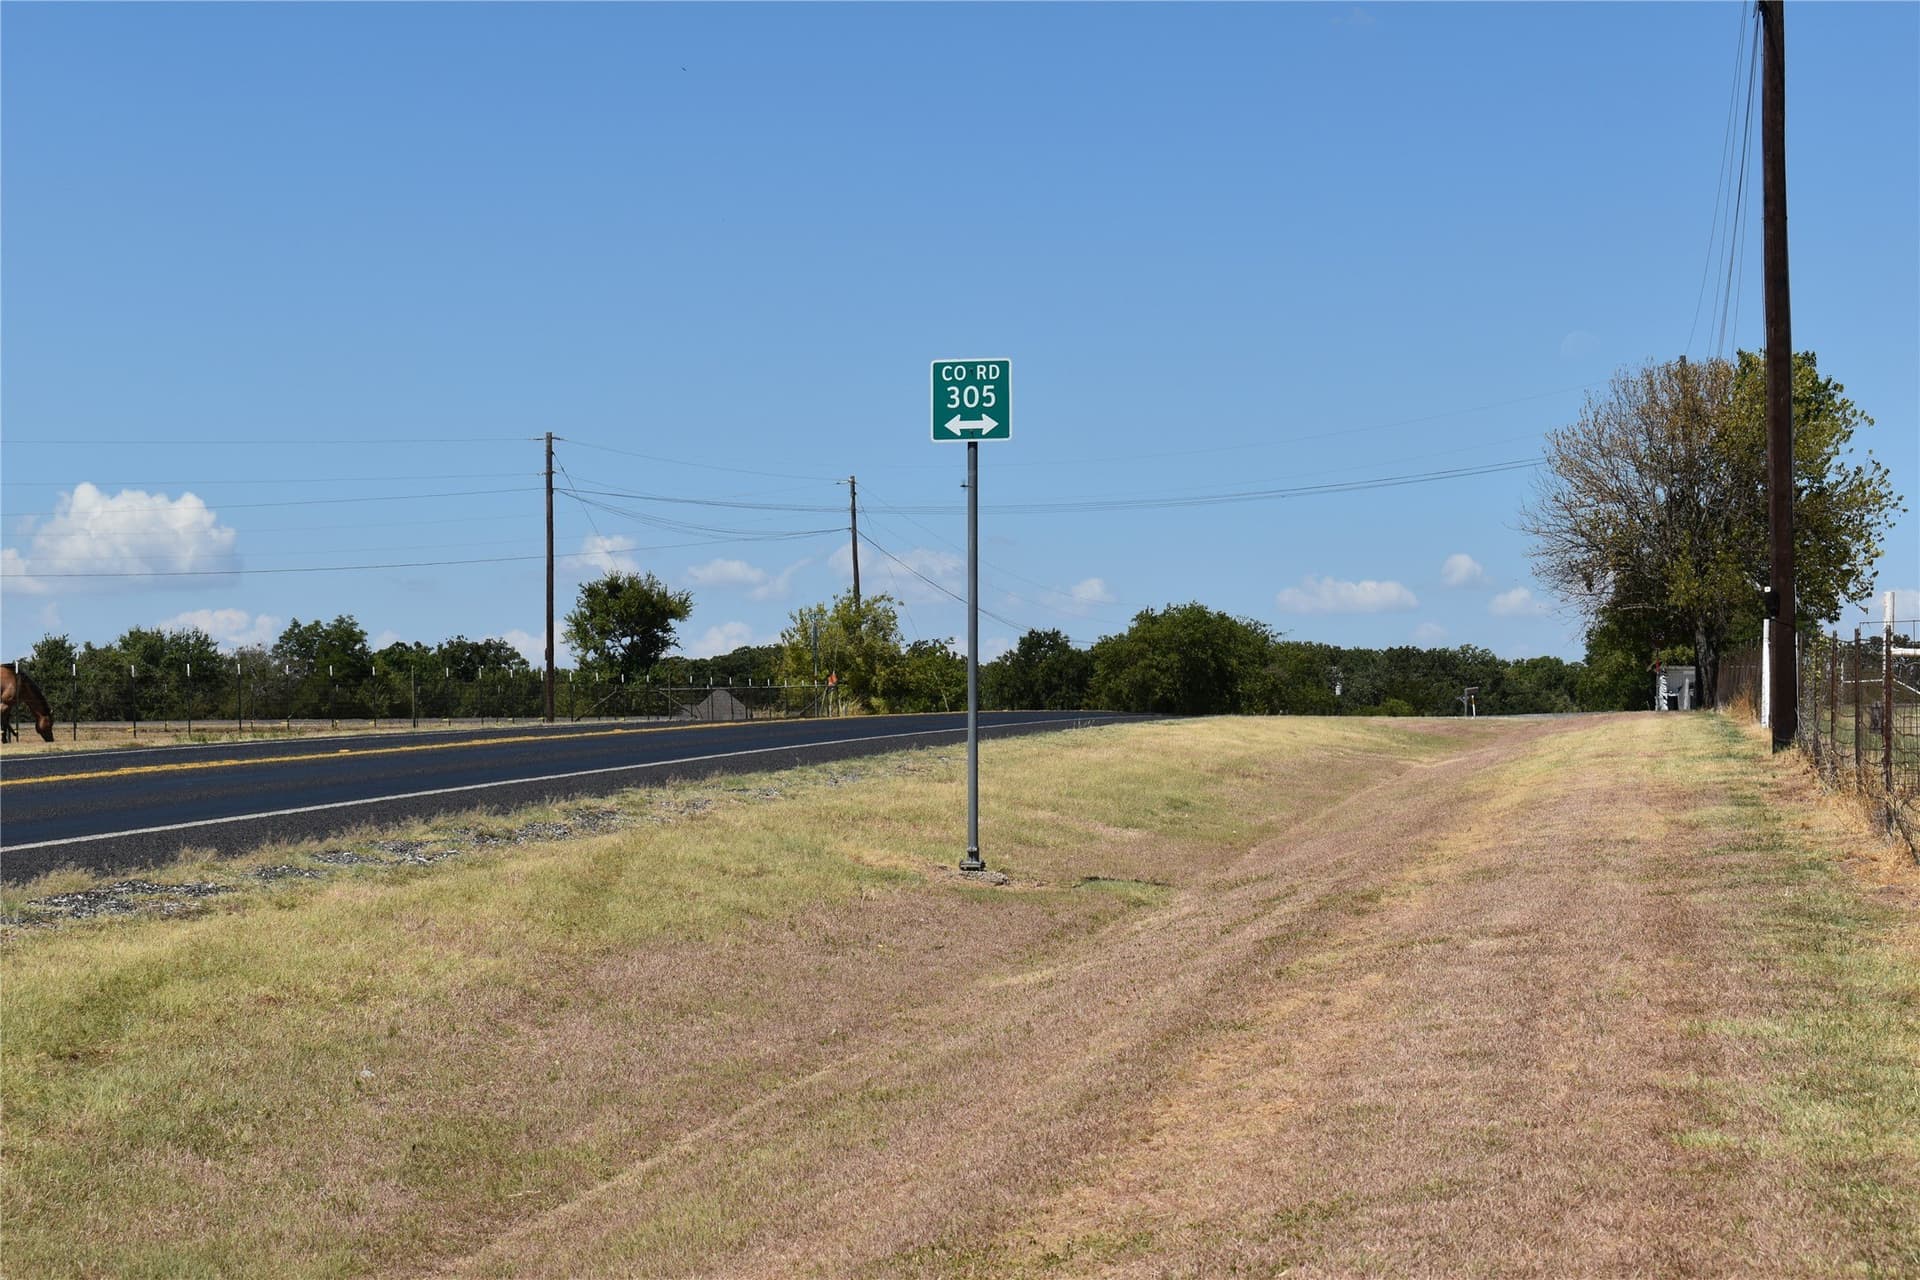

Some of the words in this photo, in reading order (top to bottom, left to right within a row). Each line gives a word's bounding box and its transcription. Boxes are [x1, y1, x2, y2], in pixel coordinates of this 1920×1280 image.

[942, 365, 966, 381] CO
[976, 364, 1000, 380] RD
[946, 385, 996, 408] 305
